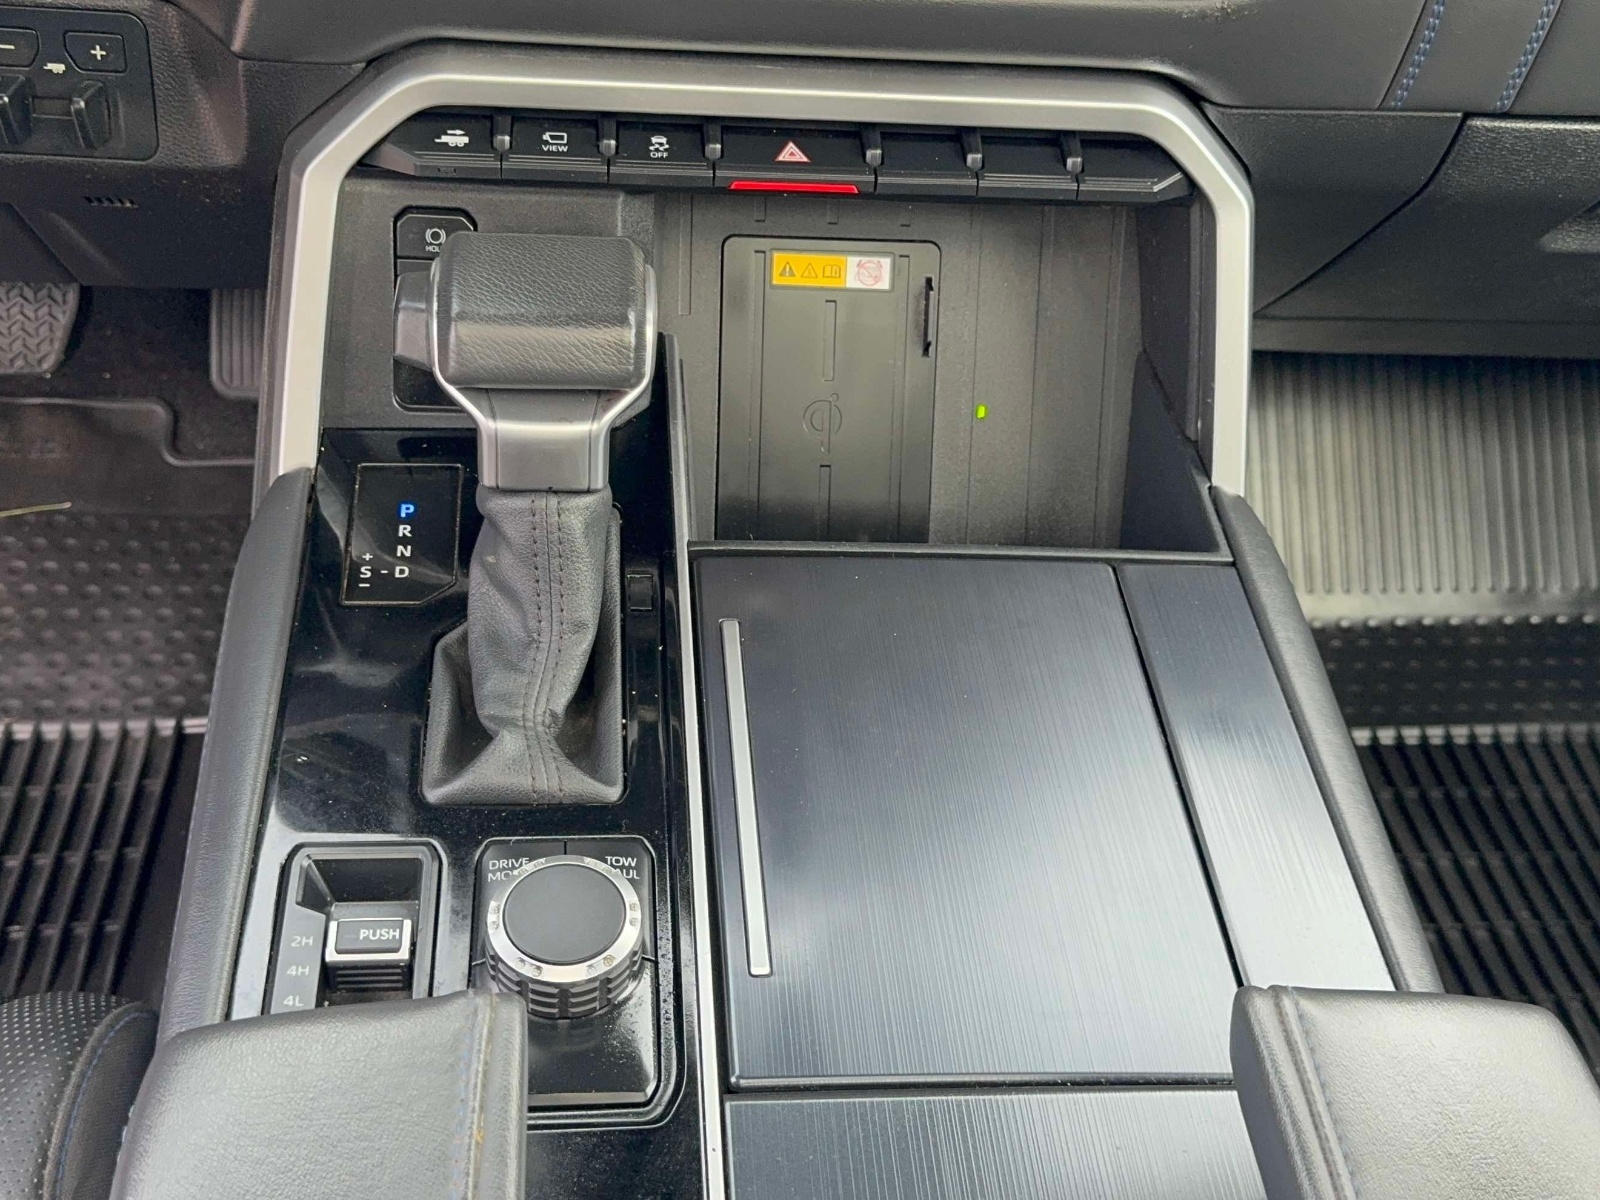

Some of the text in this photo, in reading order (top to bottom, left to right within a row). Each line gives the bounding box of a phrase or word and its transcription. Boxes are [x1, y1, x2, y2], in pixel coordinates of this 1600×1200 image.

[541, 144, 568, 152] VIEW
[400, 503, 415, 518] P
[398, 524, 412, 537] R
[396, 545, 412, 557] N
[360, 565, 372, 578] S
[394, 565, 410, 578] D
[488, 857, 530, 870] DRIVE
[605, 856, 637, 867] TOW
[359, 928, 400, 941] PUSH
[290, 935, 314, 947] 2H
[286, 965, 310, 976] 4H
[282, 995, 304, 1007] 4L
